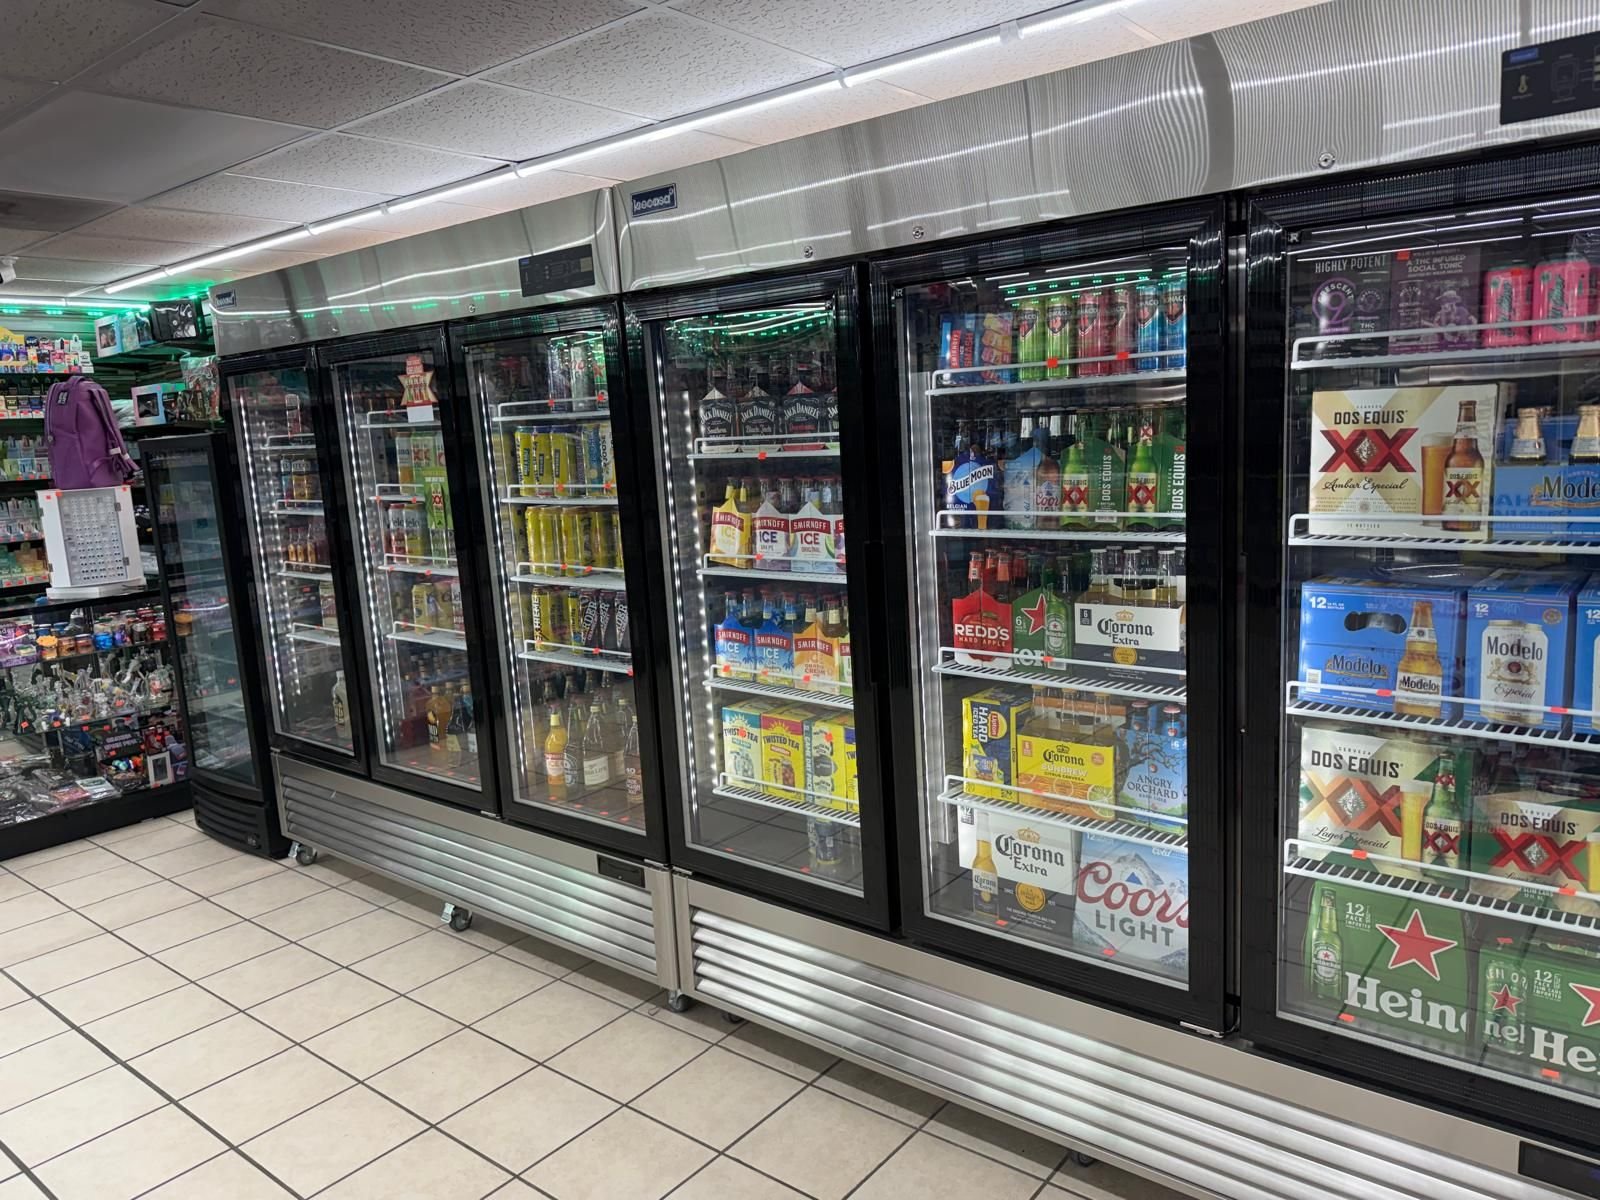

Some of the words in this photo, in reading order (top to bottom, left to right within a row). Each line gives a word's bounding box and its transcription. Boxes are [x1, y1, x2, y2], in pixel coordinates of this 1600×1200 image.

[1315, 259, 1348, 273] HIGHLY
[1350, 254, 1386, 270] POTENT
[1408, 265, 1437, 273] SOCIAL
[1440, 261, 1463, 270] TONIC
[741, 408, 753, 423] JACK
[784, 406, 796, 420] JACK
[1334, 411, 1359, 425] DOS
[1363, 410, 1405, 425] EQUIS
[1319, 428, 1419, 472] XX
[1102, 455, 1112, 482] EQUIS
[1172, 453, 1186, 486] EQUIS
[948, 479, 970, 494] BLUE
[970, 467, 993, 483] MOON
[1323, 478, 1362, 492] Ambar
[1362, 476, 1409, 494] Especial
[1063, 487, 1088, 505] XX
[1102, 484, 1111, 501] DOS
[1128, 485, 1156, 505] XX
[1445, 480, 1481, 498] XX
[1171, 488, 1184, 510] DOS
[715, 513, 742, 528] SMIRNOFF
[755, 518, 785, 529] SMIRNOFF
[793, 520, 827, 530] SMIRNOFF
[721, 526, 736, 537] ICE
[759, 532, 778, 543] ICE
[800, 533, 820, 545] ICE
[1309, 596, 1326, 609] 12
[1474, 603, 1489, 613] 12
[1016, 616, 1022, 626] 6
[1097, 618, 1153, 637] Corona
[718, 631, 747, 642] SMIRNOFF
[954, 623, 1010, 641] REDD'S
[1112, 634, 1140, 646] Extra
[724, 642, 740, 653] ICE
[756, 636, 788, 647] SMIRNOFF
[798, 641, 830, 652] SMIRNOFF
[982, 639, 1006, 647] APPLE
[1487, 636, 1543, 660] Modelo
[763, 647, 780, 659] ICE
[1333, 654, 1381, 674] Modelo
[1402, 675, 1437, 691] Modelo
[1494, 684, 1536, 699] Especial
[979, 706, 989, 743] HARD
[724, 728, 746, 738] TWIST
[747, 731, 758, 743] TEA
[763, 735, 788, 745] TWISTED
[788, 739, 800, 751] TEA
[1043, 749, 1085, 766] Corona
[1312, 750, 1343, 770] DOS
[1348, 756, 1400, 779] EQUIS
[1137, 775, 1173, 789] ANGRY
[1127, 782, 1179, 799] ORCHARD
[1302, 771, 1402, 837] XX
[1426, 821, 1438, 830] DOS
[1501, 812, 1528, 828] DOS
[1532, 817, 1576, 835] EQUIS
[1312, 827, 1344, 844] Lager
[1424, 830, 1459, 855] XX
[995, 833, 1065, 867] Corona
[1489, 828, 1589, 882] XX
[1014, 857, 1048, 877] Extra
[1345, 902, 1365, 917] 12
[1345, 914, 1363, 923] PACK
[1095, 909, 1174, 947] LIGHT
[1534, 969, 1552, 983] 12
[1534, 980, 1550, 988] PACK
